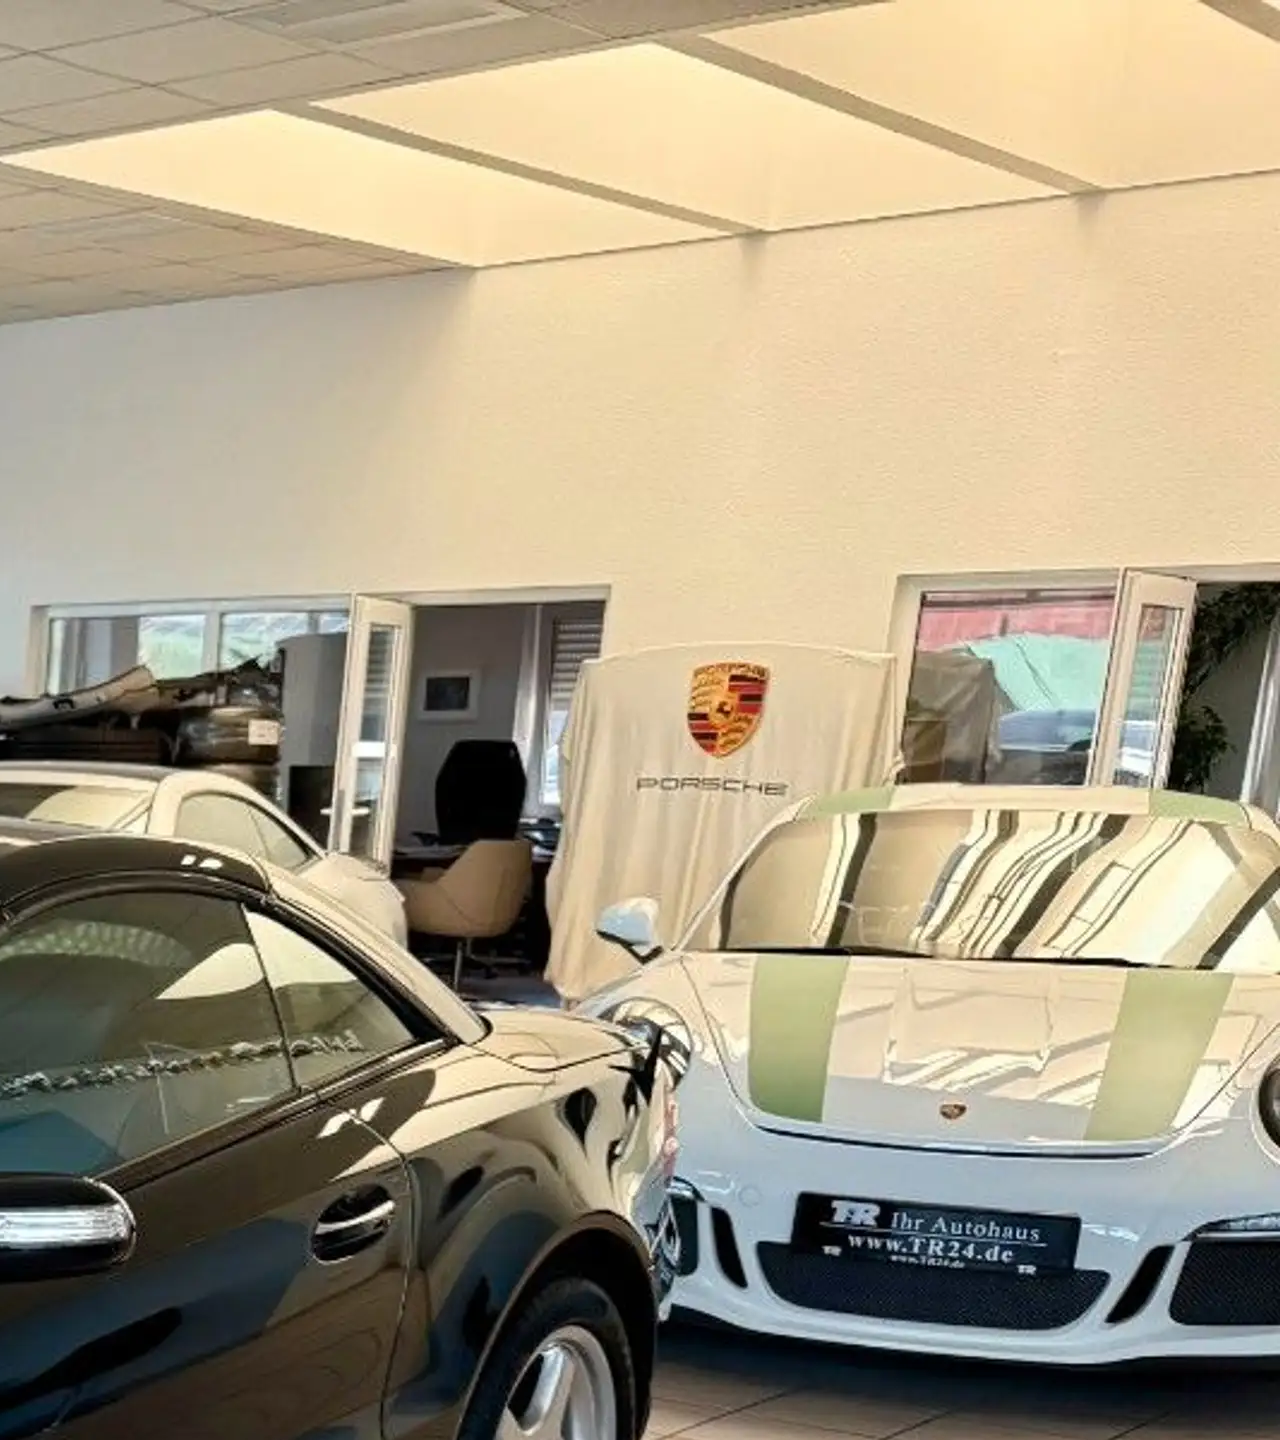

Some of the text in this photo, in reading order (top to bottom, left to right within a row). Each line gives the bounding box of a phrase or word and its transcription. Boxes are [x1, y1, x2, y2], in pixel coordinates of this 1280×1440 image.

[636, 776, 789, 796] PORSCHE
[891, 1211, 924, 1231] Ihr
[930, 1216, 1040, 1242] Autohaus
[848, 1234, 1014, 1264] www.TR24.de
